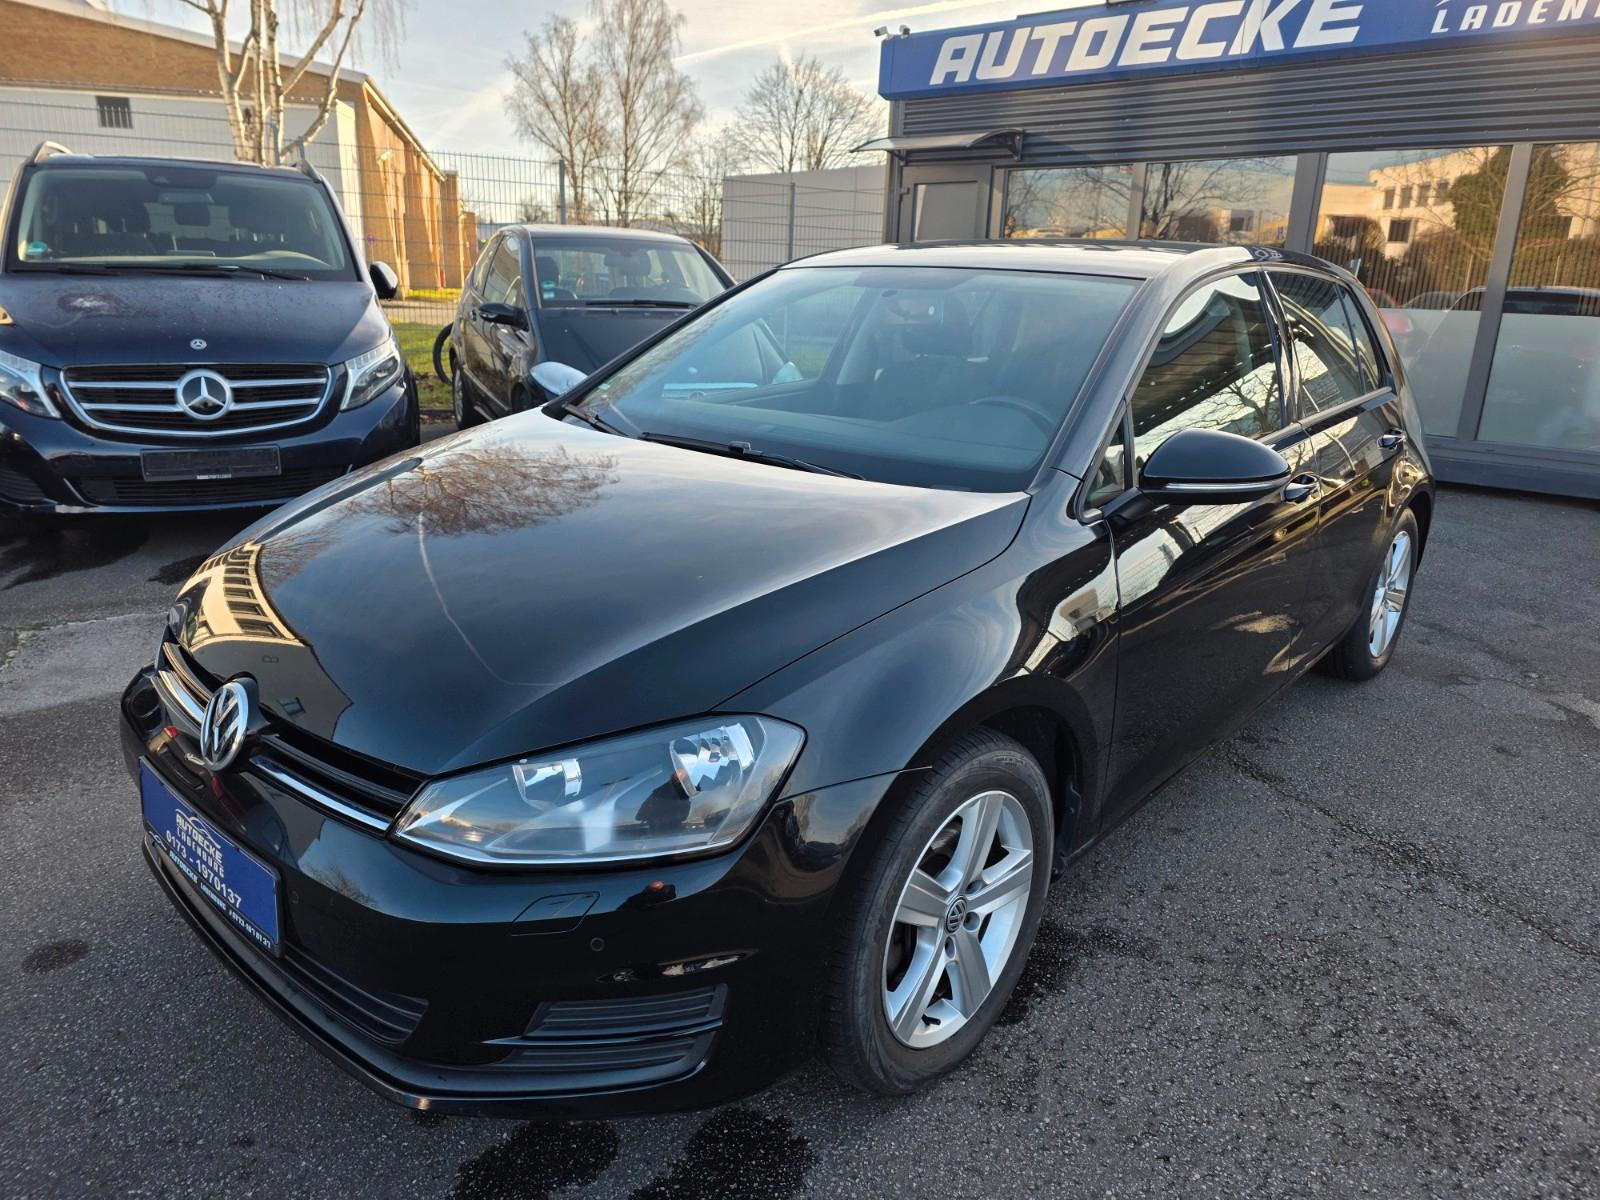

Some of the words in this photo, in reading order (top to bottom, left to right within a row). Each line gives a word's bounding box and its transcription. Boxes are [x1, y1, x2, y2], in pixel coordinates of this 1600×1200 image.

[929, 0, 1364, 85] AUTOECKE
[1431, 0, 1600, 34] LADEN
[166, 829, 187, 858] 0173
[195, 859, 242, 908] 1970137
[175, 812, 222, 863] AUTOECKE
